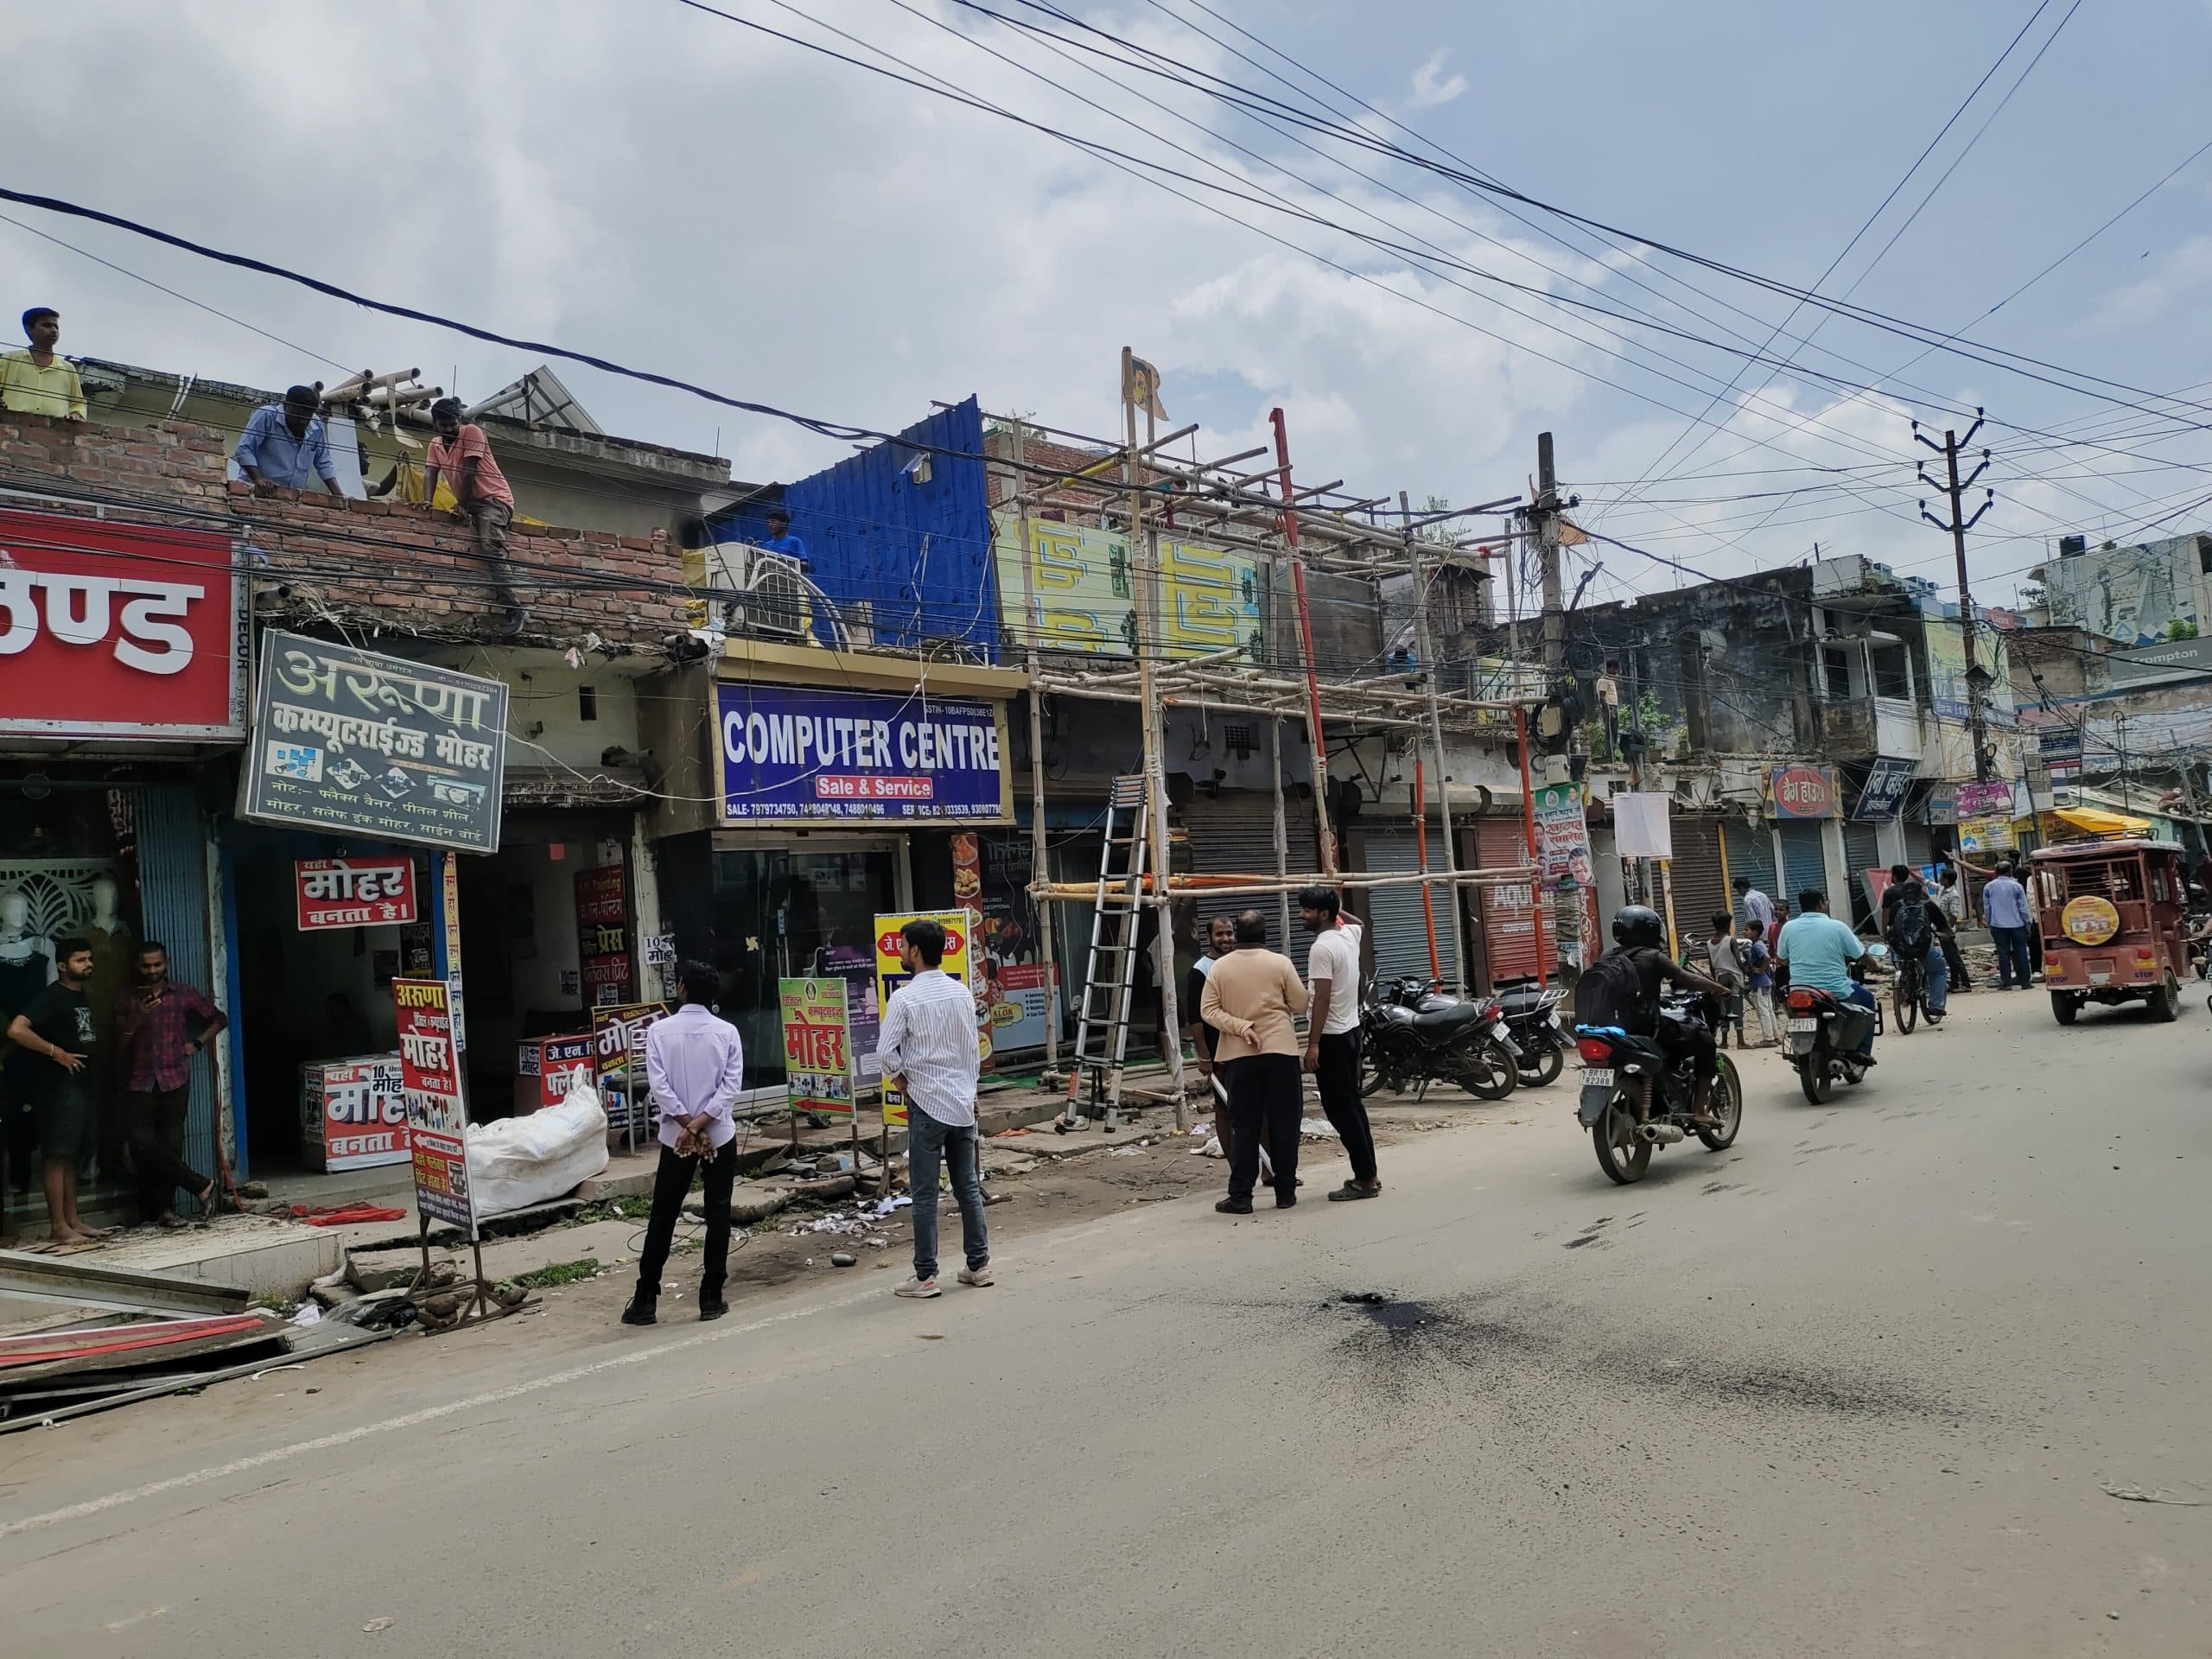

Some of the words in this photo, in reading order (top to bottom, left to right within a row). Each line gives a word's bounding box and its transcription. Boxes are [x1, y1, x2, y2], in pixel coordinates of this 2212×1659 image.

[2131, 648, 2199, 664] Crompton
[723, 710, 893, 768] COMPUTER
[899, 721, 1000, 771] CENTRE
[435, 729, 493, 772] मोहर
[819, 779, 853, 796] Sale
[859, 779, 871, 797] &
[874, 779, 931, 797] Service
[402, 799, 437, 817] पीतल
[727, 804, 750, 816] SALE-
[300, 859, 405, 902] मोहर
[307, 907, 372, 925] बनता
[993, 1008, 1014, 1018] ALOK
[784, 1009, 846, 1068] मोहर
[399, 1025, 450, 1071] मोहर
[547, 1046, 562, 1060] जे.
[564, 1045, 584, 1058] एन.
[372, 1065, 385, 1078] 10
[1588, 1069, 1608, 1077] BR19
[372, 1073, 404, 1093] मोह
[328, 1133, 395, 1155] बनता
